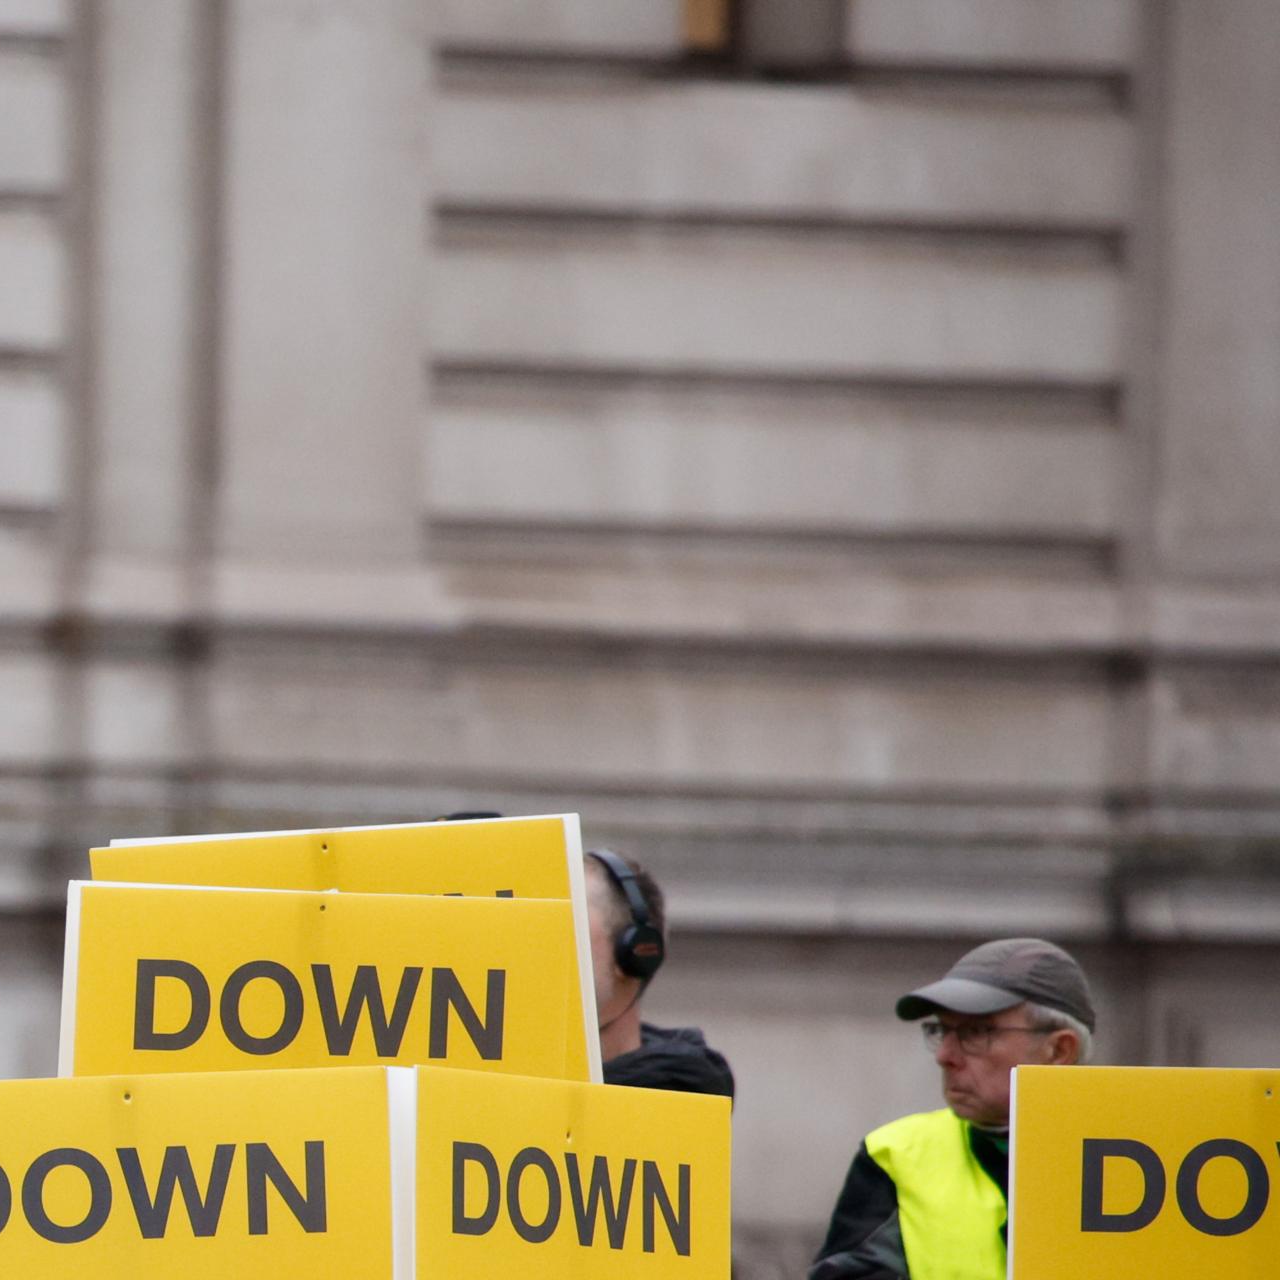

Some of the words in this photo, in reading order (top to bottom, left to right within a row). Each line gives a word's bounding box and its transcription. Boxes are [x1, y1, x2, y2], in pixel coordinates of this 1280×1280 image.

[134, 960, 505, 1060] DOWN
[453, 1142, 690, 1256] DOWN
[1081, 1139, 1280, 1236] DO
